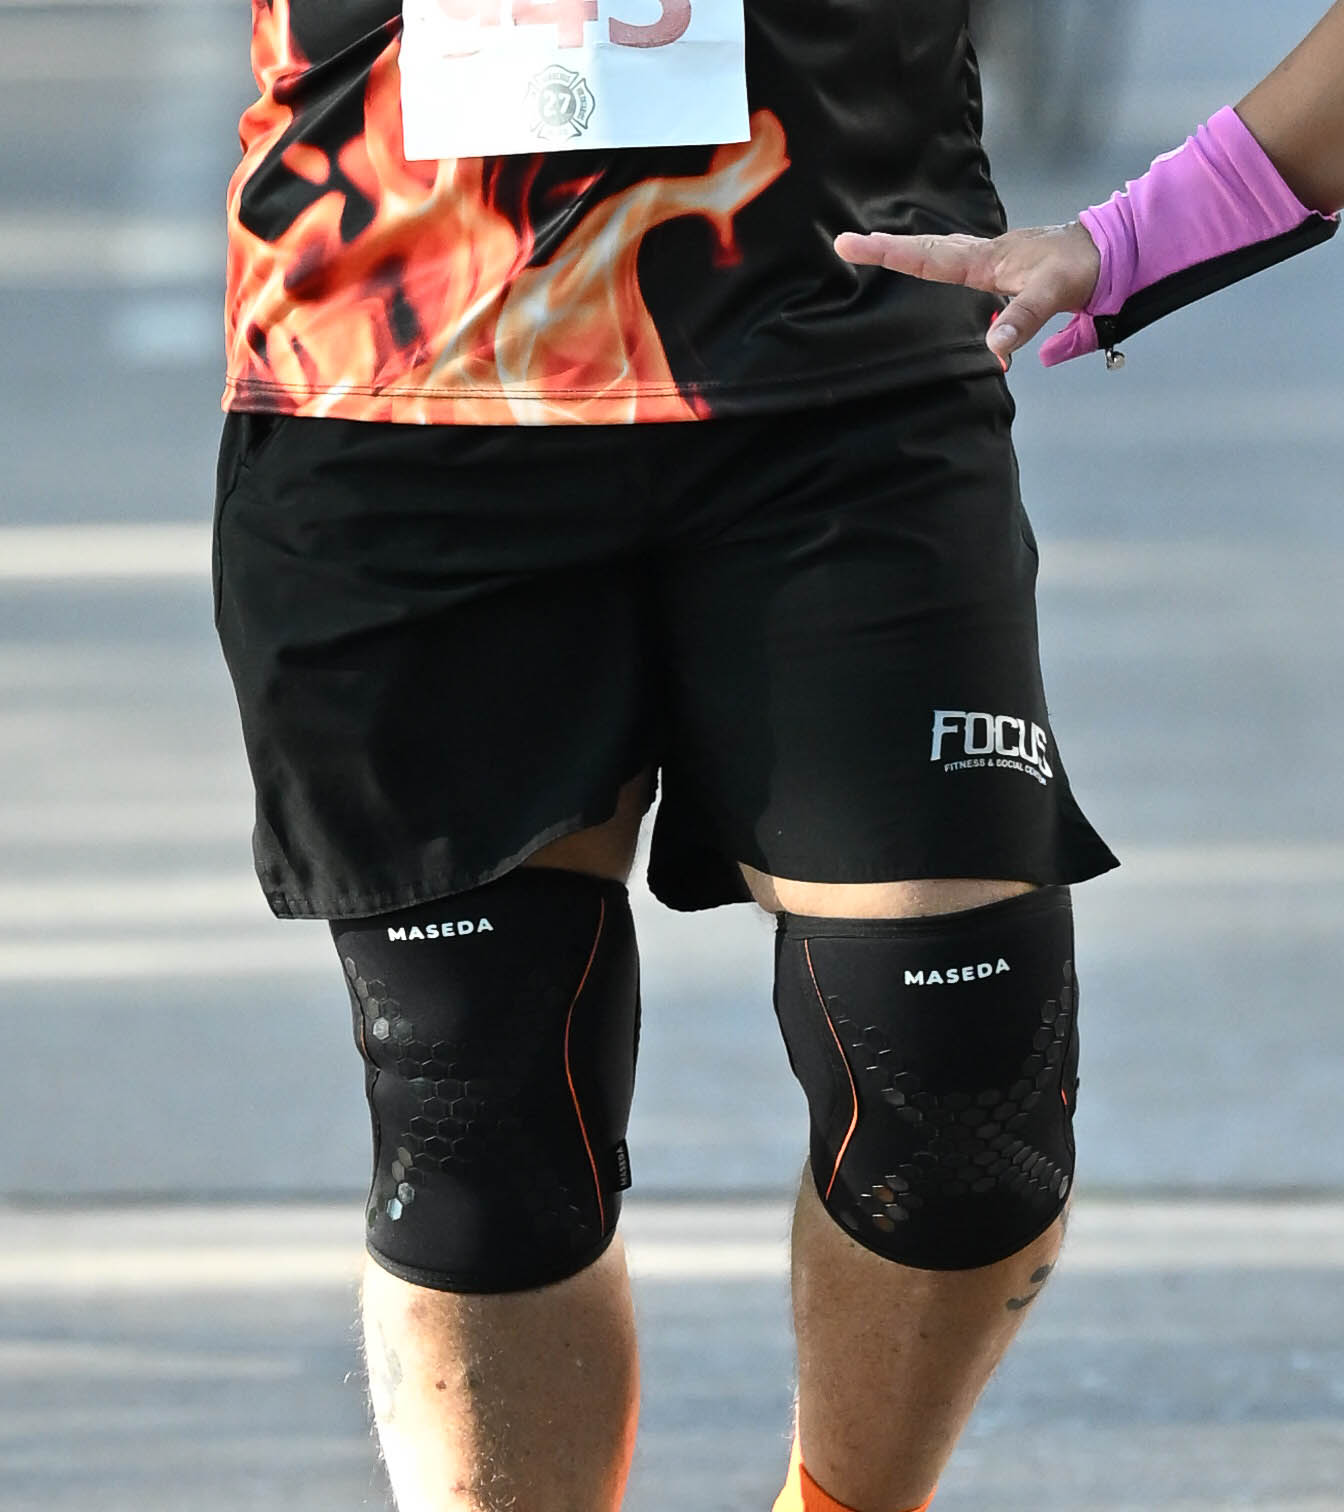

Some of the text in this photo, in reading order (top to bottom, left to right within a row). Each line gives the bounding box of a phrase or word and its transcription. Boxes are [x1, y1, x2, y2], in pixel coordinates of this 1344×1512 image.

[930, 709, 1053, 778] FOCUS
[944, 758, 986, 773] FITNESS
[387, 918, 494, 942] MASEDA
[904, 958, 1010, 986] MASEDA
